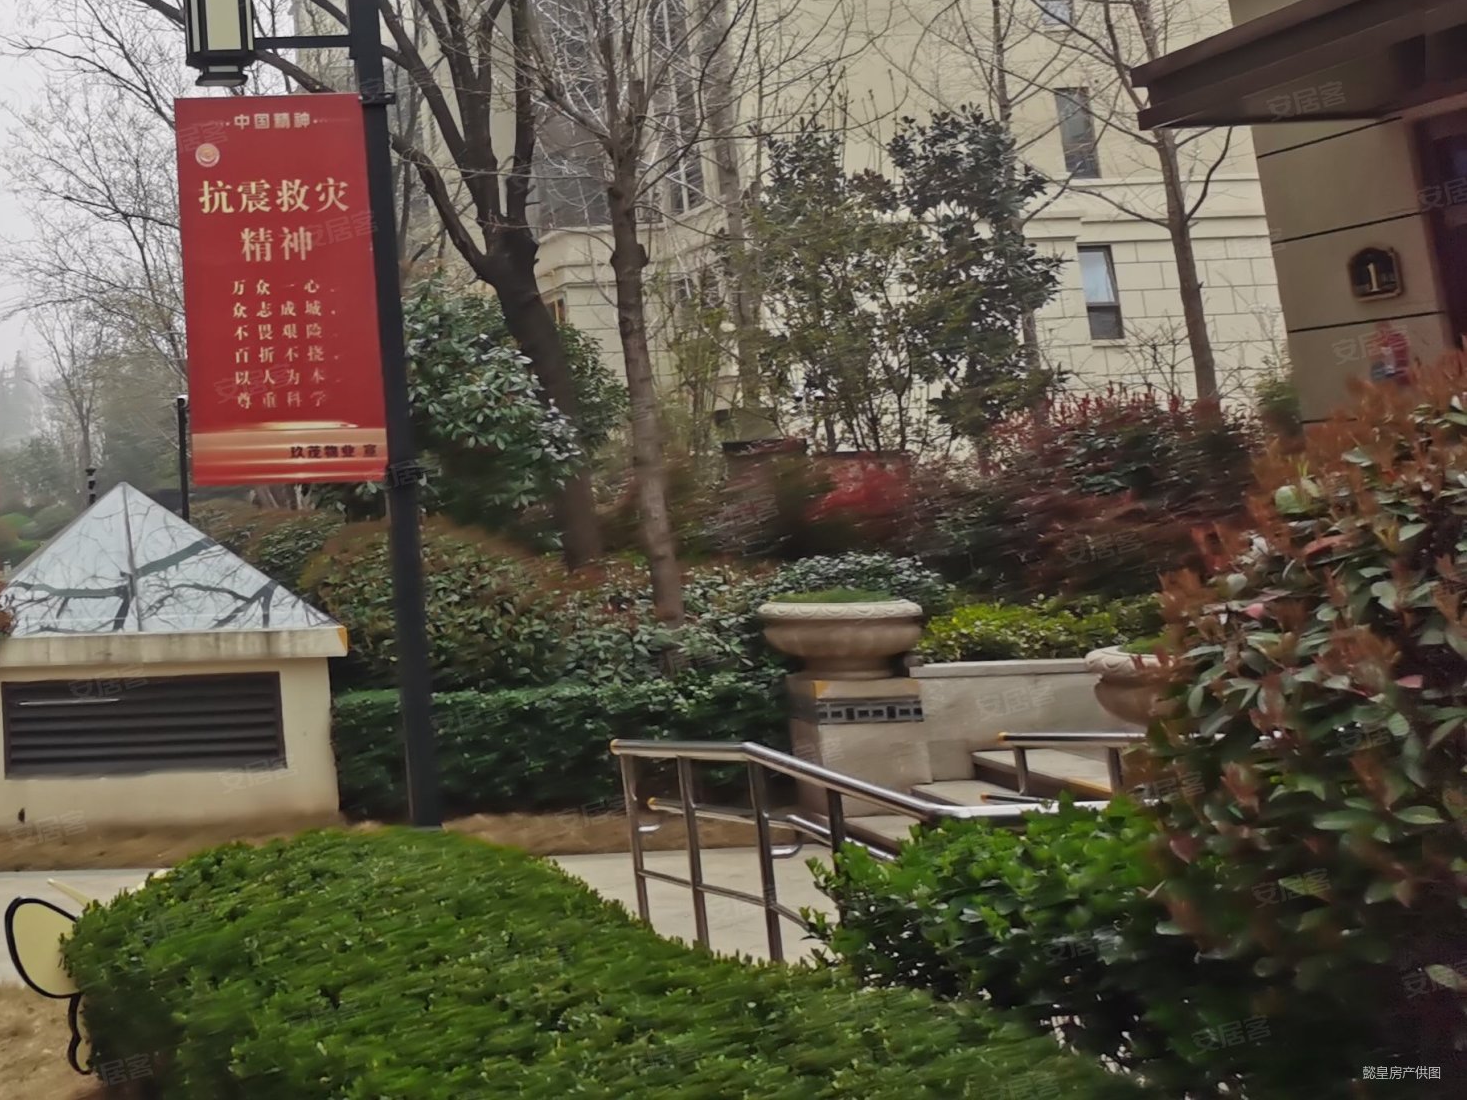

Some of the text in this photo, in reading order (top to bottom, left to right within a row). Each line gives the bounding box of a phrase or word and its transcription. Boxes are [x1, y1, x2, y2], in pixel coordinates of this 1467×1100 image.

[234, 112, 310, 130] 中国精神
[199, 177, 349, 214] 抗震救灾
[240, 226, 313, 262] 精神
[1367, 262, 1381, 292] 1
[237, 391, 326, 409] 尊重科学
